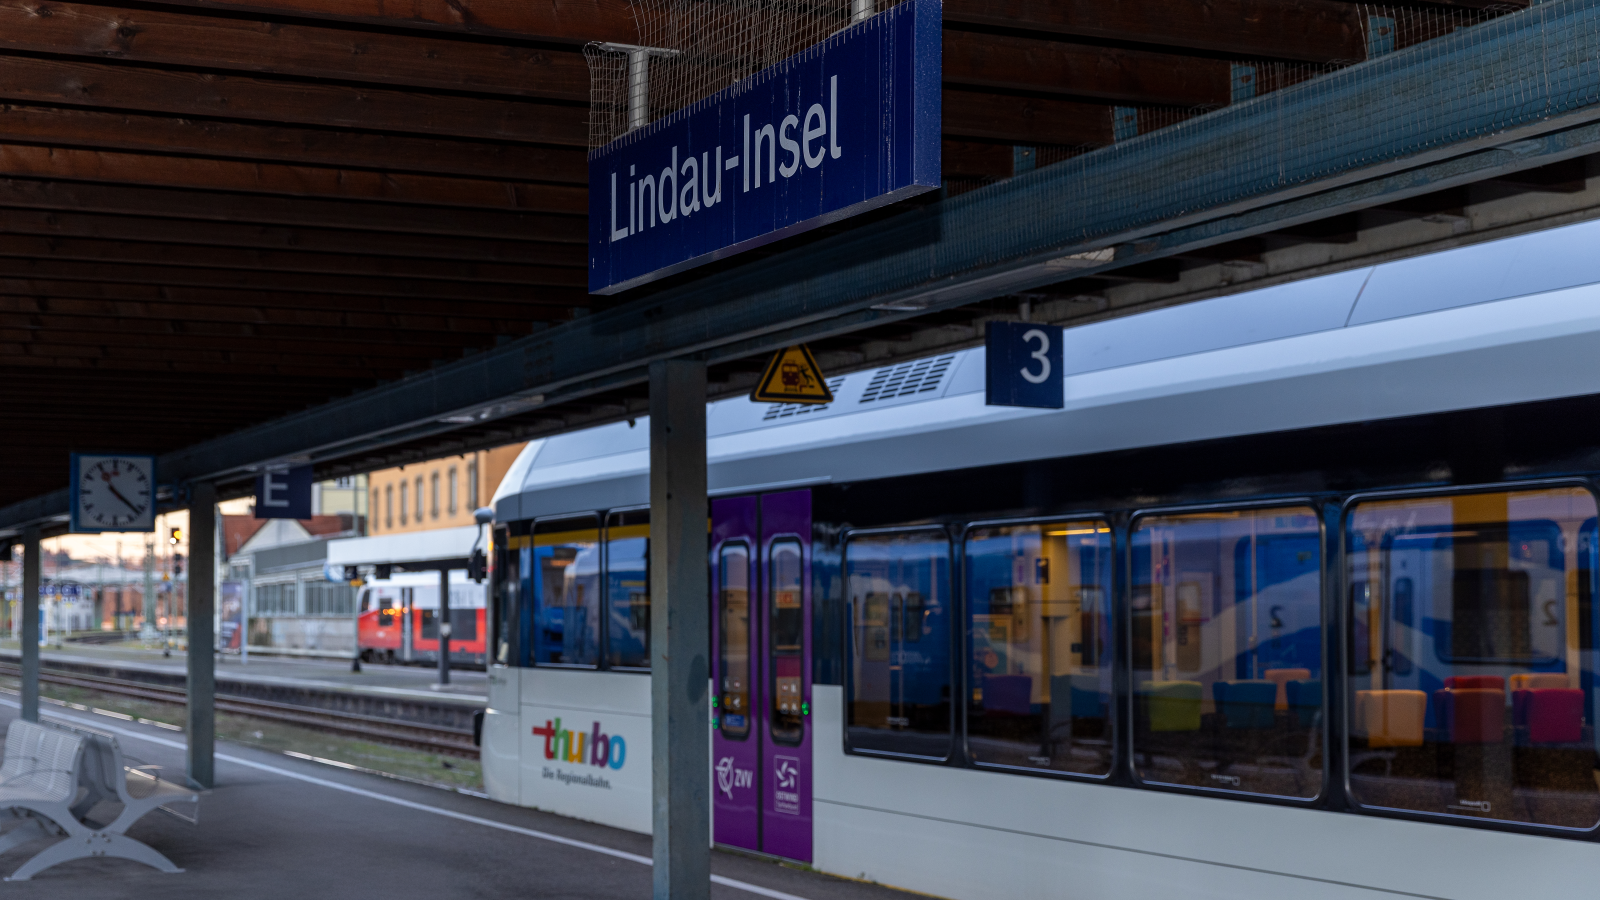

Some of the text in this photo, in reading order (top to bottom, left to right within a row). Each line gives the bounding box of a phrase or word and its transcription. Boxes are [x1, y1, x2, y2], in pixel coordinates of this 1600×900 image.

[610, 74, 842, 242] Lindau-Insel
[1020, 329, 1051, 384] 3
[263, 466, 290, 507] E
[532, 717, 626, 770] thurbo
[542, 766, 554, 779] Die
[734, 768, 753, 789] ZVV
